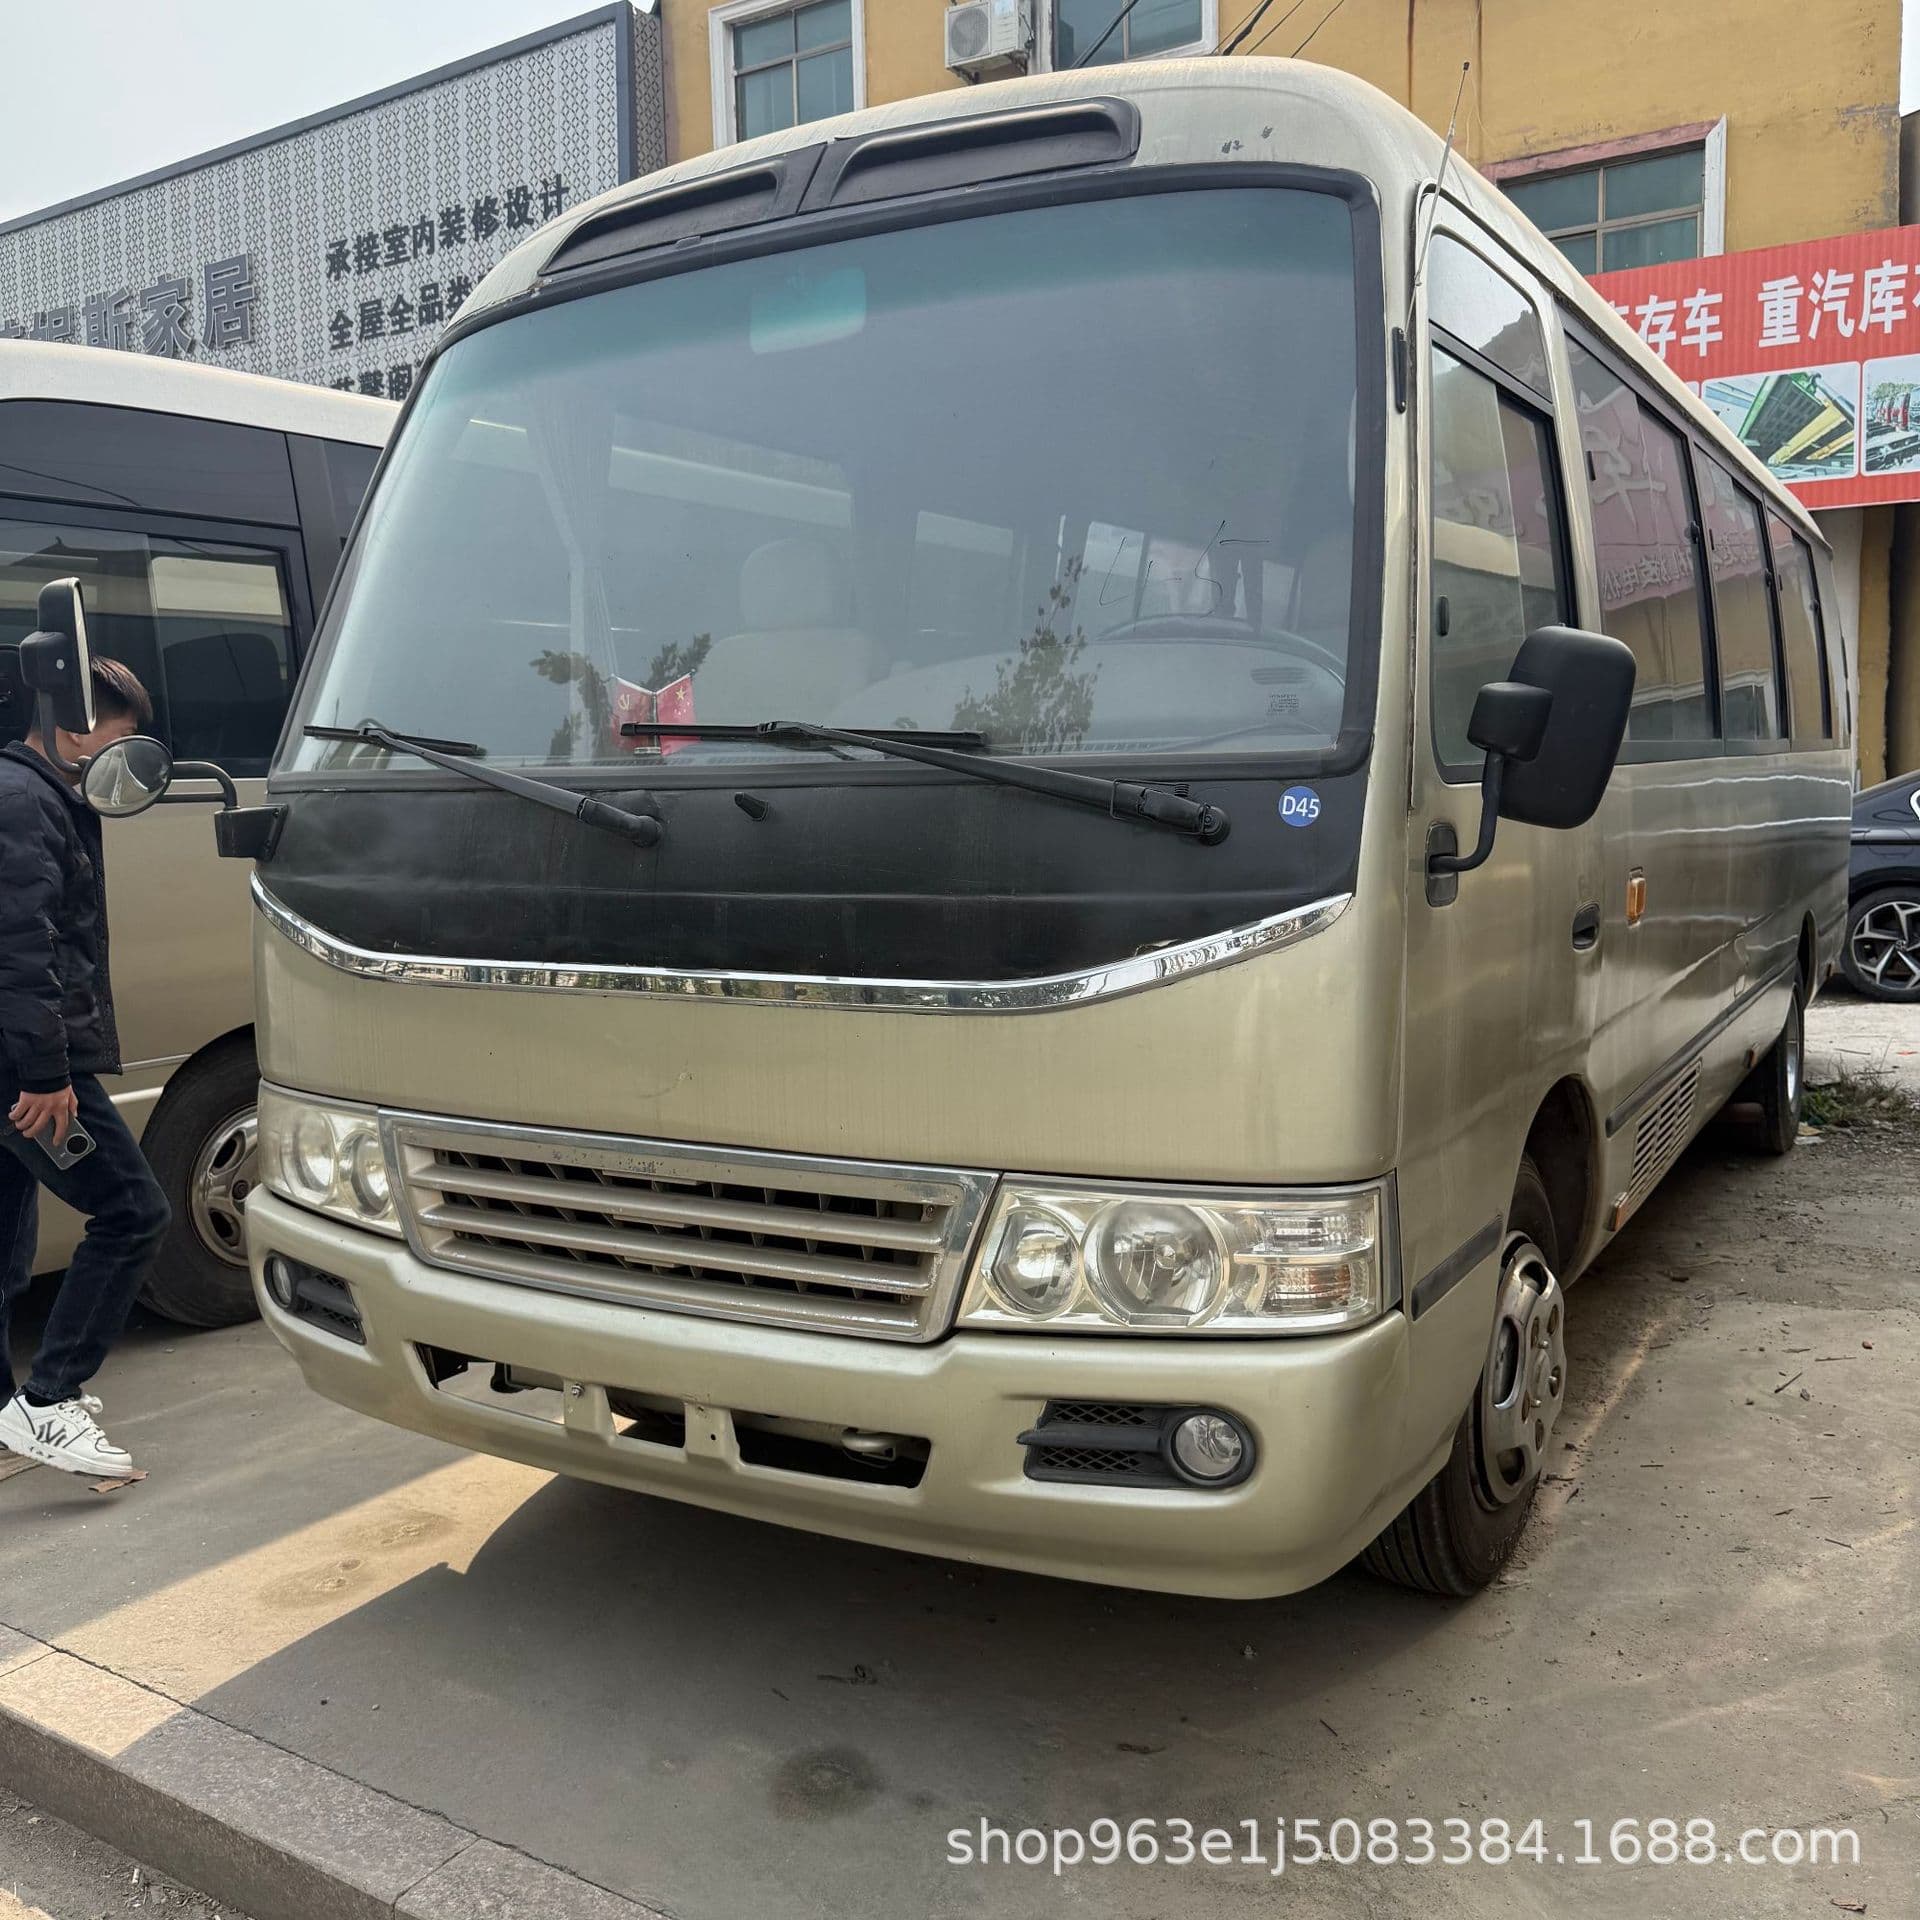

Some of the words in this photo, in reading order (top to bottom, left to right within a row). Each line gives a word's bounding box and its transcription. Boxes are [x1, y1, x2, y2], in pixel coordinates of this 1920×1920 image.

[326, 173, 570, 281] 承接室内装修设计
[0, 253, 255, 358] 斯家居
[328, 274, 487, 350] 全屋全品类
[1758, 259, 1920, 348] 重汽库
[1282, 795, 1320, 818] D45
